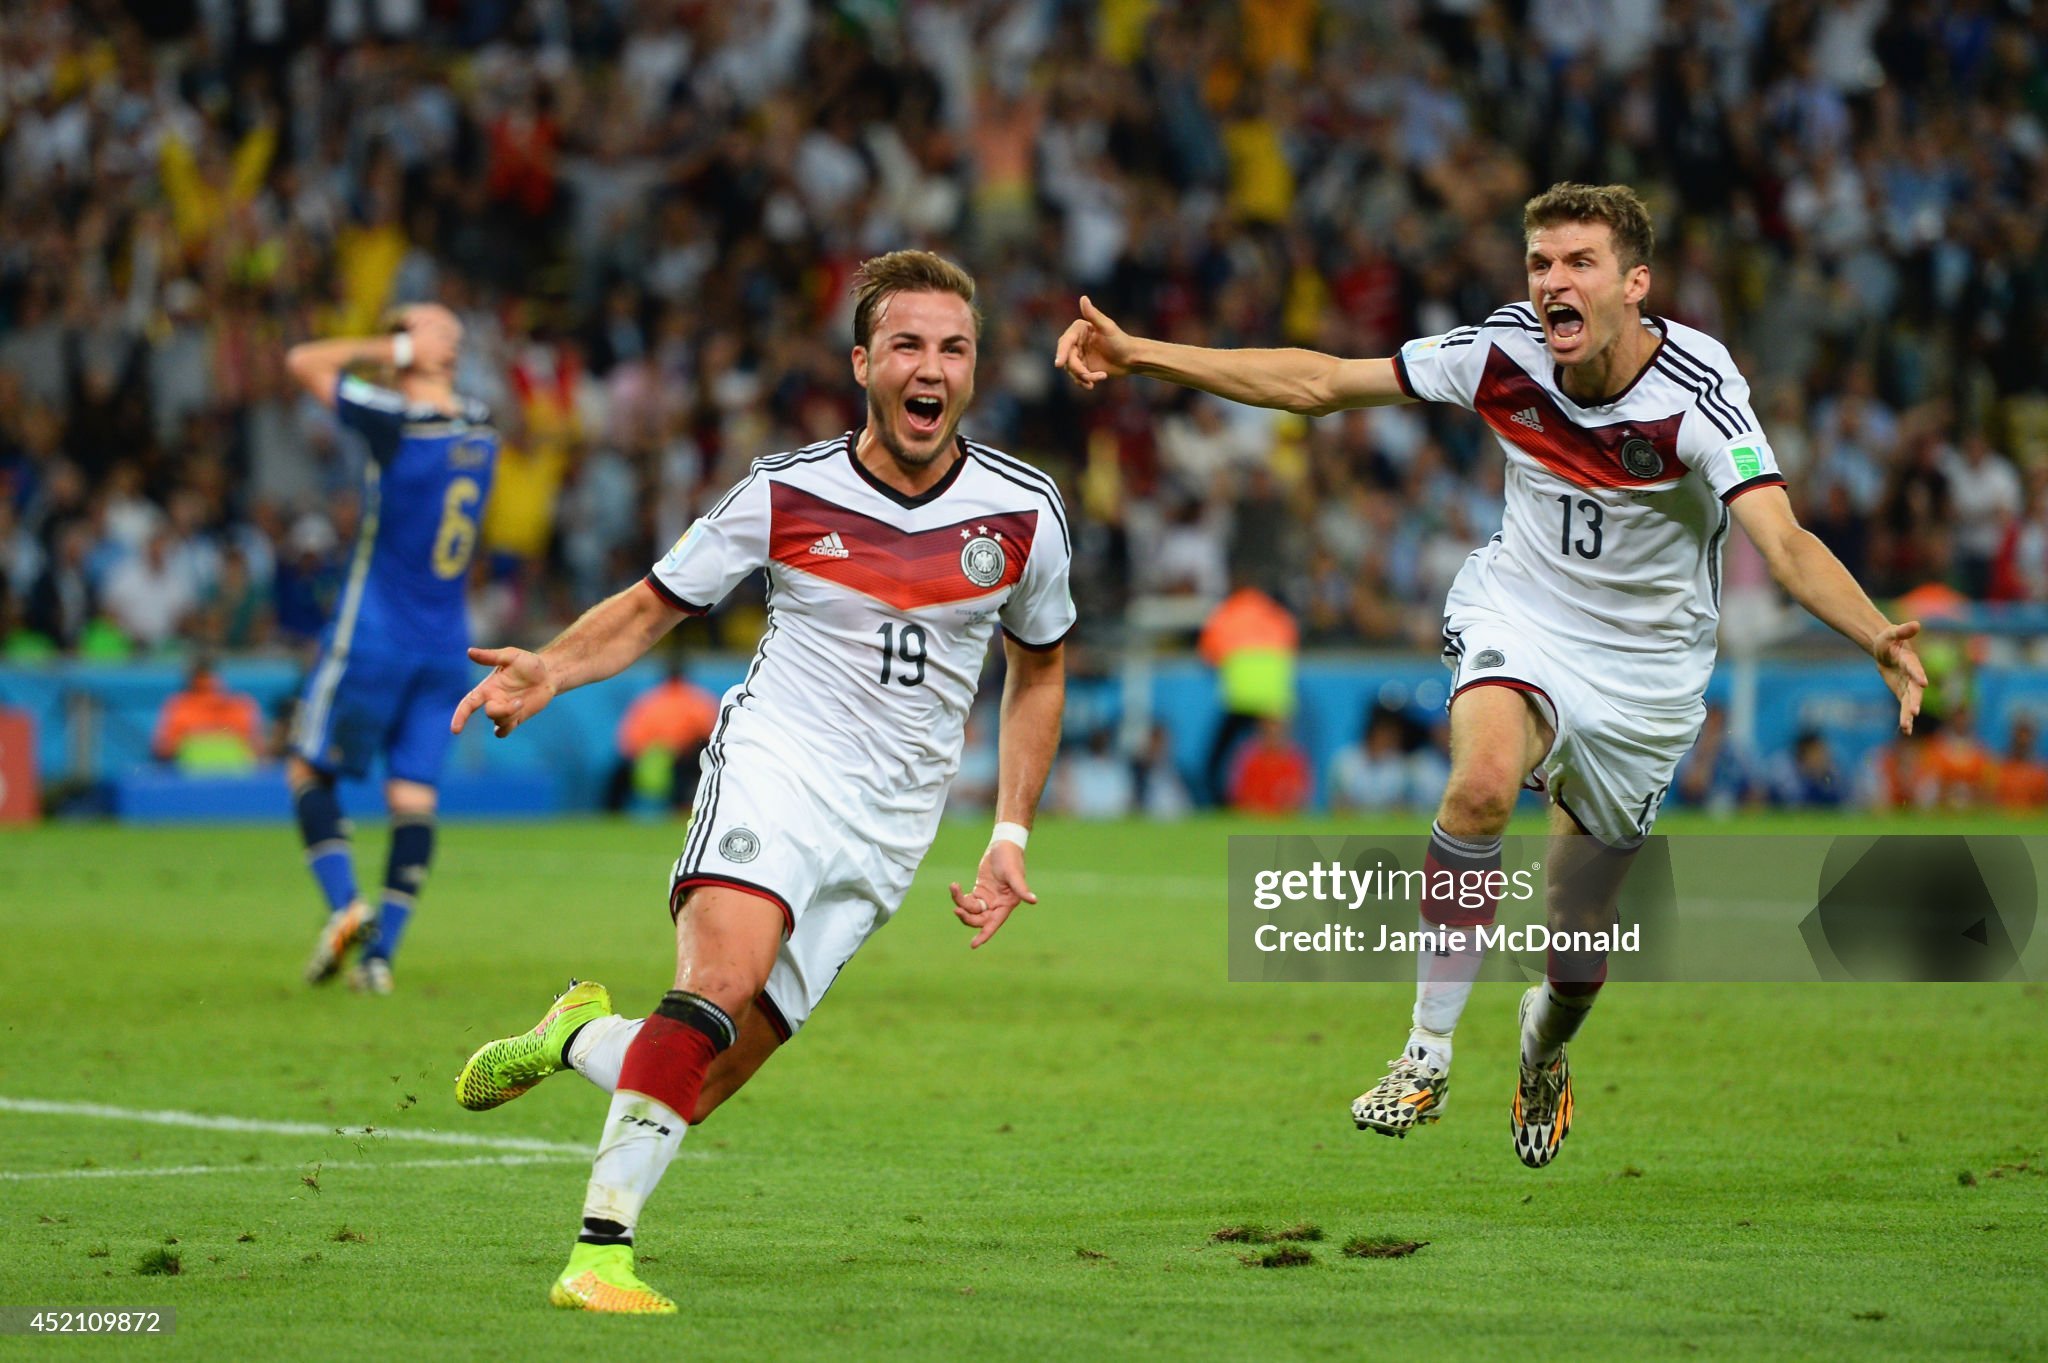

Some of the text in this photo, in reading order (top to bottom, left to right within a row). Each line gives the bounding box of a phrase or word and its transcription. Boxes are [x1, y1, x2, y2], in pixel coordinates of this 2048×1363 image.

[1510, 414, 1544, 433] adidas
[432, 476, 480, 580] 6
[809, 545, 849, 559] adidas
[1557, 493, 1604, 560] 13
[876, 622, 928, 687] 19
